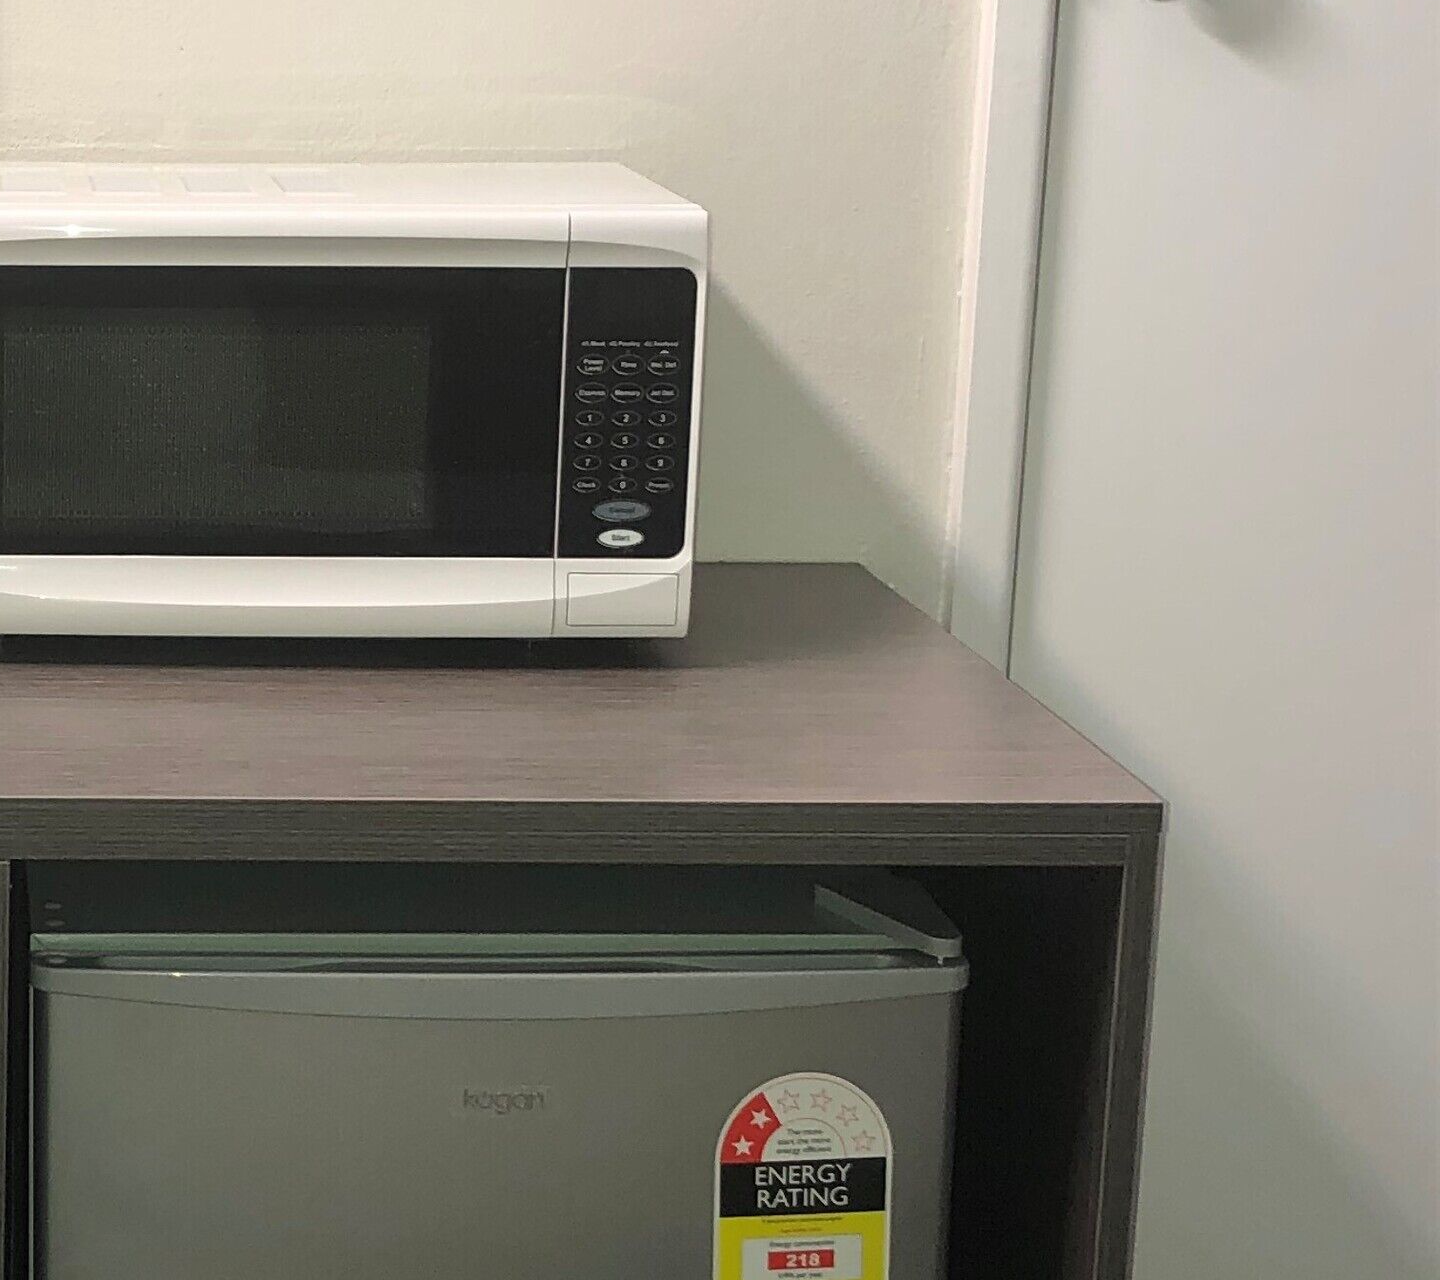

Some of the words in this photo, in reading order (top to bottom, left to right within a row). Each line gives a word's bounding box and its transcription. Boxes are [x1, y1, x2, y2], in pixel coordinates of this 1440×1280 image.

[754, 1163, 851, 1187] ENERGY
[757, 1186, 849, 1209] RATING
[786, 1253, 820, 1267] 218
